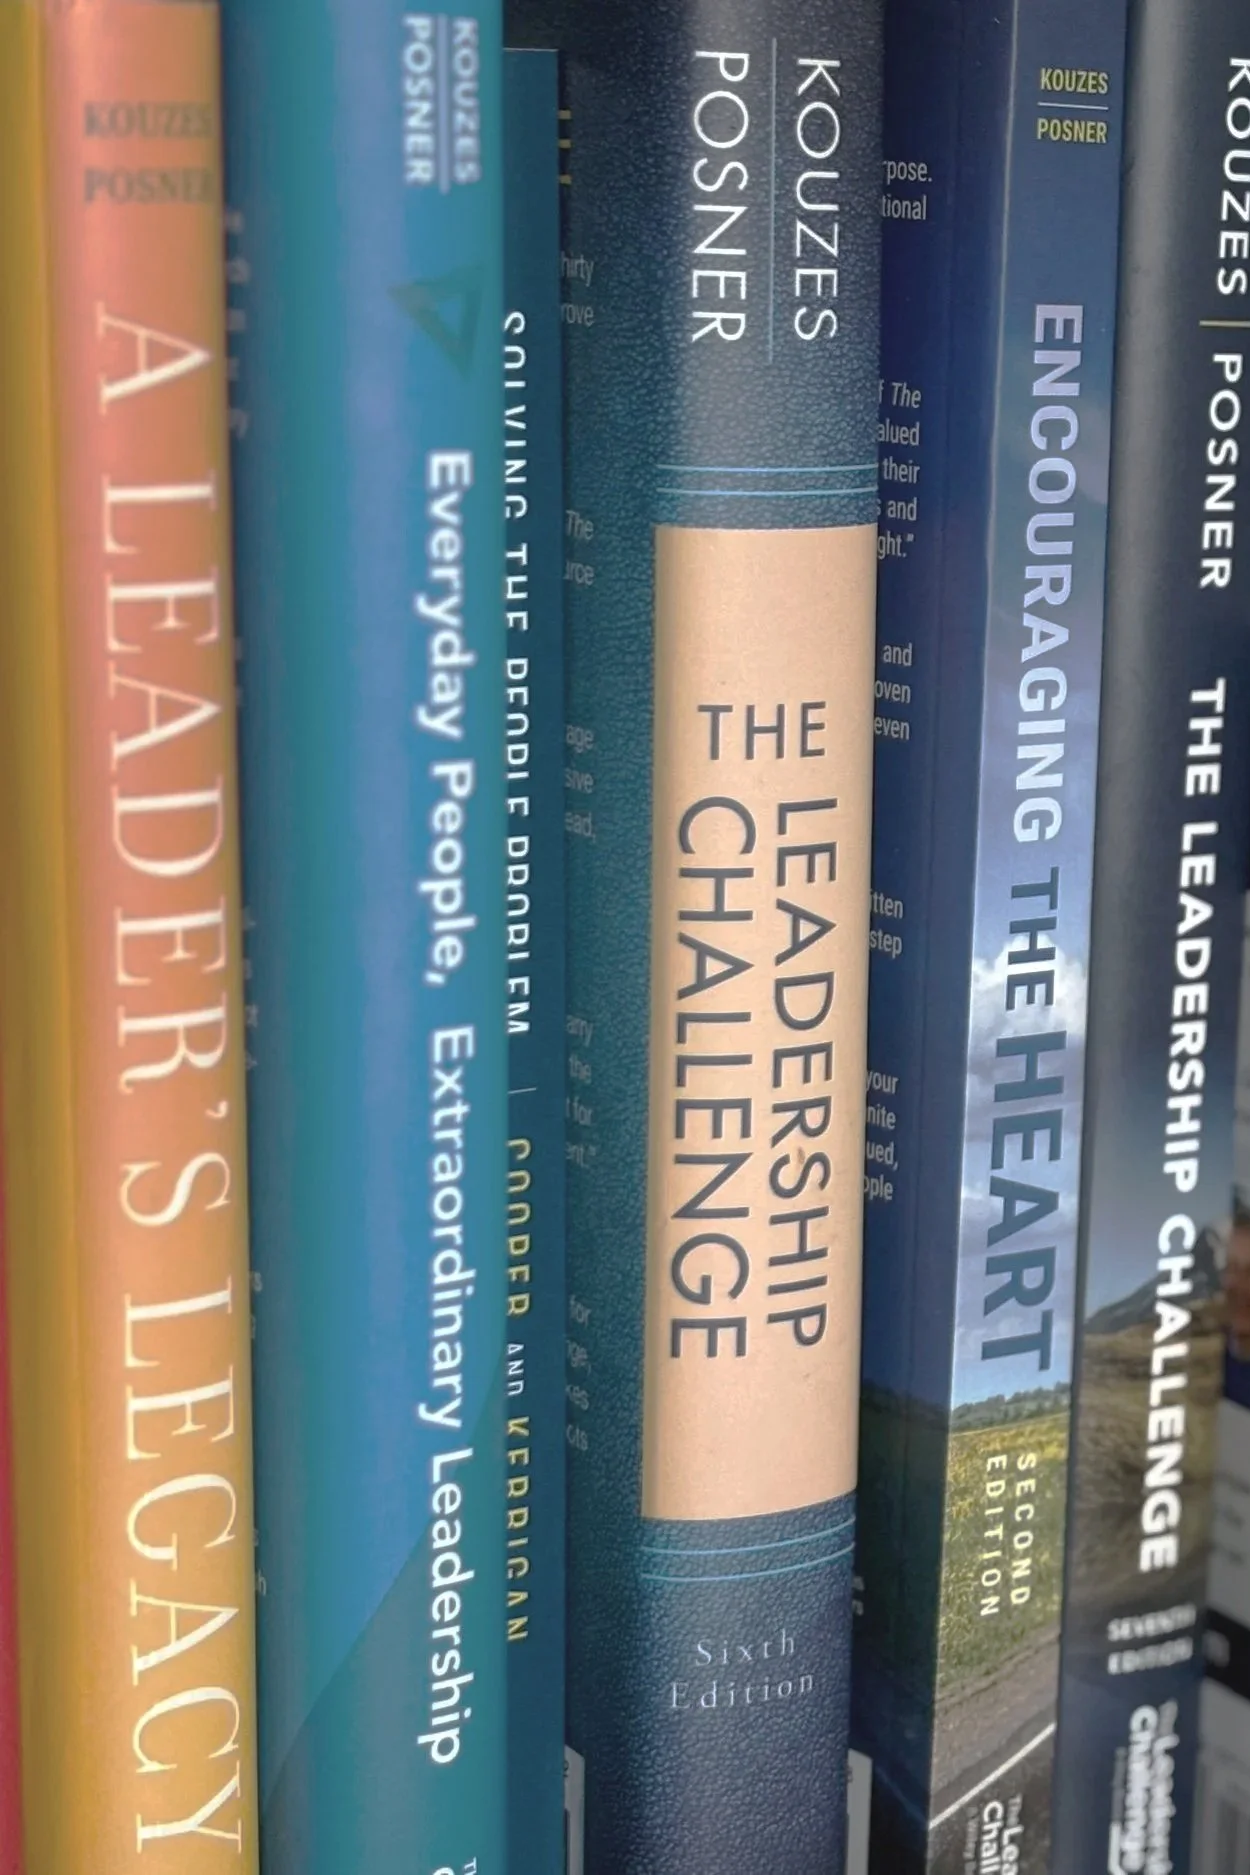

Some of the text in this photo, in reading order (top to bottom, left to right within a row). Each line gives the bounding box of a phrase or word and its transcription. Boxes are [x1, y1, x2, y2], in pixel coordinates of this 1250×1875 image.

[403, 14, 434, 187] POSNER
[453, 16, 480, 184] KOUZES
[1036, 117, 1108, 144] POSNER
[1039, 67, 1109, 95] KOUZES
[692, 50, 750, 343] POSNER
[794, 57, 841, 341] KOUZES
[882, 455, 921, 484] their
[891, 381, 922, 409] The
[1199, 352, 1244, 590] POSNER
[697, 700, 827, 761] THE
[1184, 676, 1227, 797] THE
[980, 304, 1084, 1372] ENCOURAGING THE HEART
[97, 300, 243, 1855] A LEADER'S LEGACY
[670, 796, 756, 1359] CHALLENGE
[767, 797, 838, 1347] LEADERSHIP
[1163, 820, 1219, 1194] LEADERSHIP
[414, 449, 477, 1765] Everyday People, Extraordinary Leadership
[1138, 1212, 1198, 1574] CHALLENGE
[980, 1453, 1008, 1618] EDITION
[1010, 1451, 1037, 1606] SECOND
[670, 1672, 815, 1710] Edition
[694, 1628, 796, 1668] Sixth
